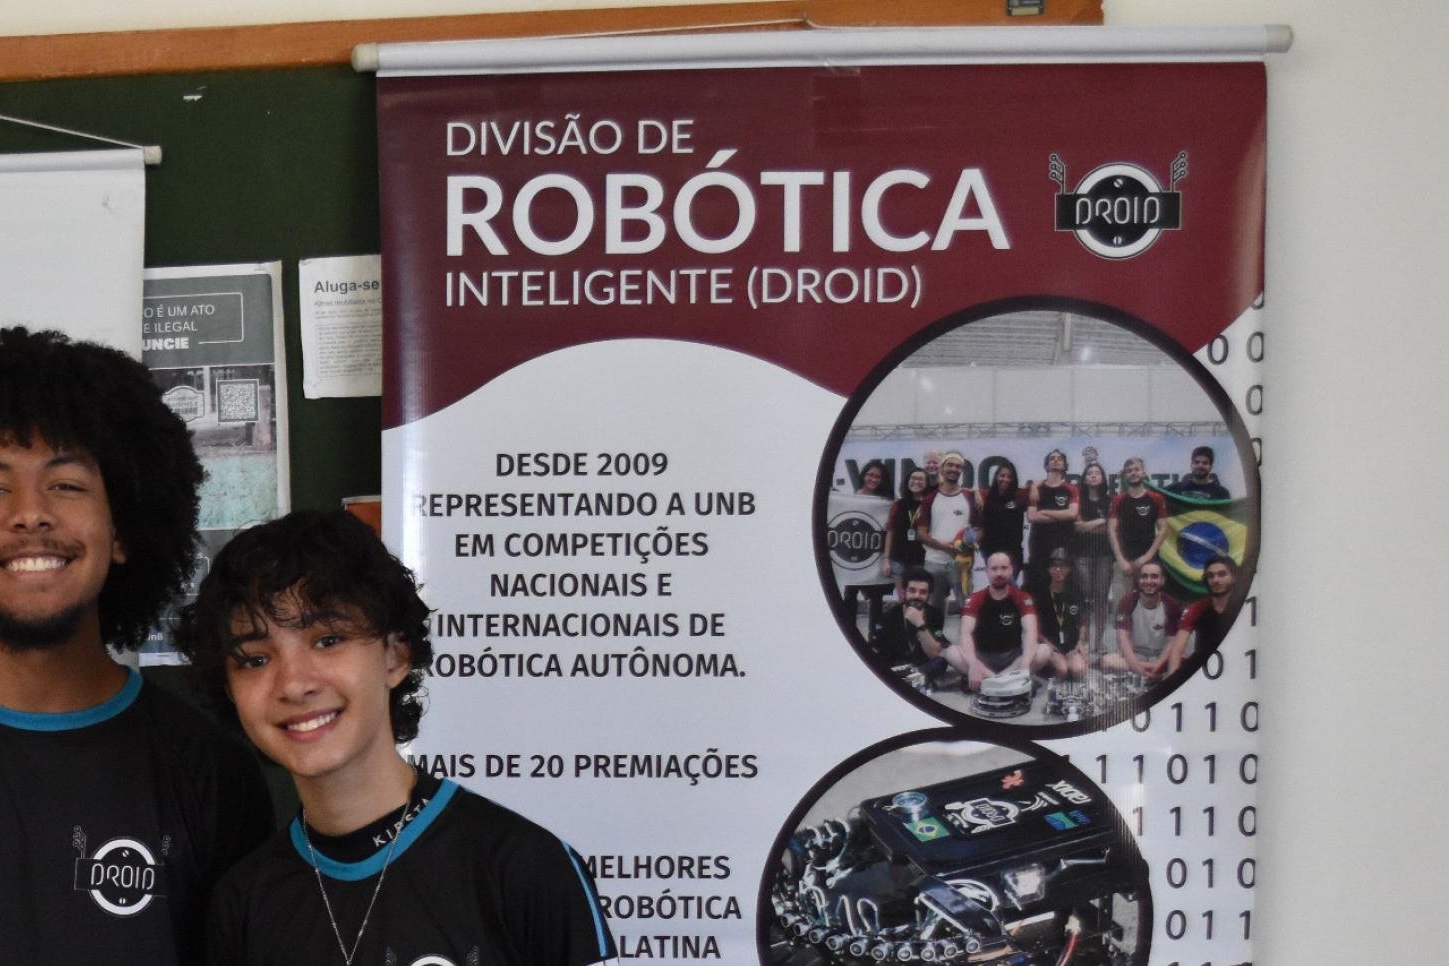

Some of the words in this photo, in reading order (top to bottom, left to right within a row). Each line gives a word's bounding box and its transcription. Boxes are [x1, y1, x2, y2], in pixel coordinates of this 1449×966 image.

[446, 113, 623, 156] DIVISÃO
[637, 119, 694, 154] DE
[446, 149, 1011, 256] ROBÓTICA
[1075, 196, 1161, 225] DROID
[314, 280, 380, 297] Aluga-se
[446, 268, 733, 307] INTELIGENTE
[747, 264, 922, 309] (DROID)
[167, 305, 187, 317] UM
[190, 303, 215, 316] ATO
[154, 320, 198, 333] ILEGAL
[142, 336, 189, 351] UNCIE
[496, 453, 588, 477] DESDE
[597, 452, 668, 477] 2009
[666, 492, 686, 516] A
[694, 492, 756, 516] UNB
[455, 533, 495, 557] EM
[504, 526, 709, 563] COMPETIÇÕES
[490, 572, 648, 598] NACIONAIS
[657, 572, 673, 596] E
[437, 612, 679, 638] INTERNACIONAIS
[689, 612, 726, 637] DE
[570, 645, 746, 678] AUTÔNOMA.
[485, 754, 521, 779] DE
[530, 754, 564, 778] 20
[574, 748, 759, 786] PREMIAÇÕES
[91, 862, 155, 891] DROID
[598, 888, 742, 920] ROBÓTICA
[619, 935, 721, 959] LATINA
